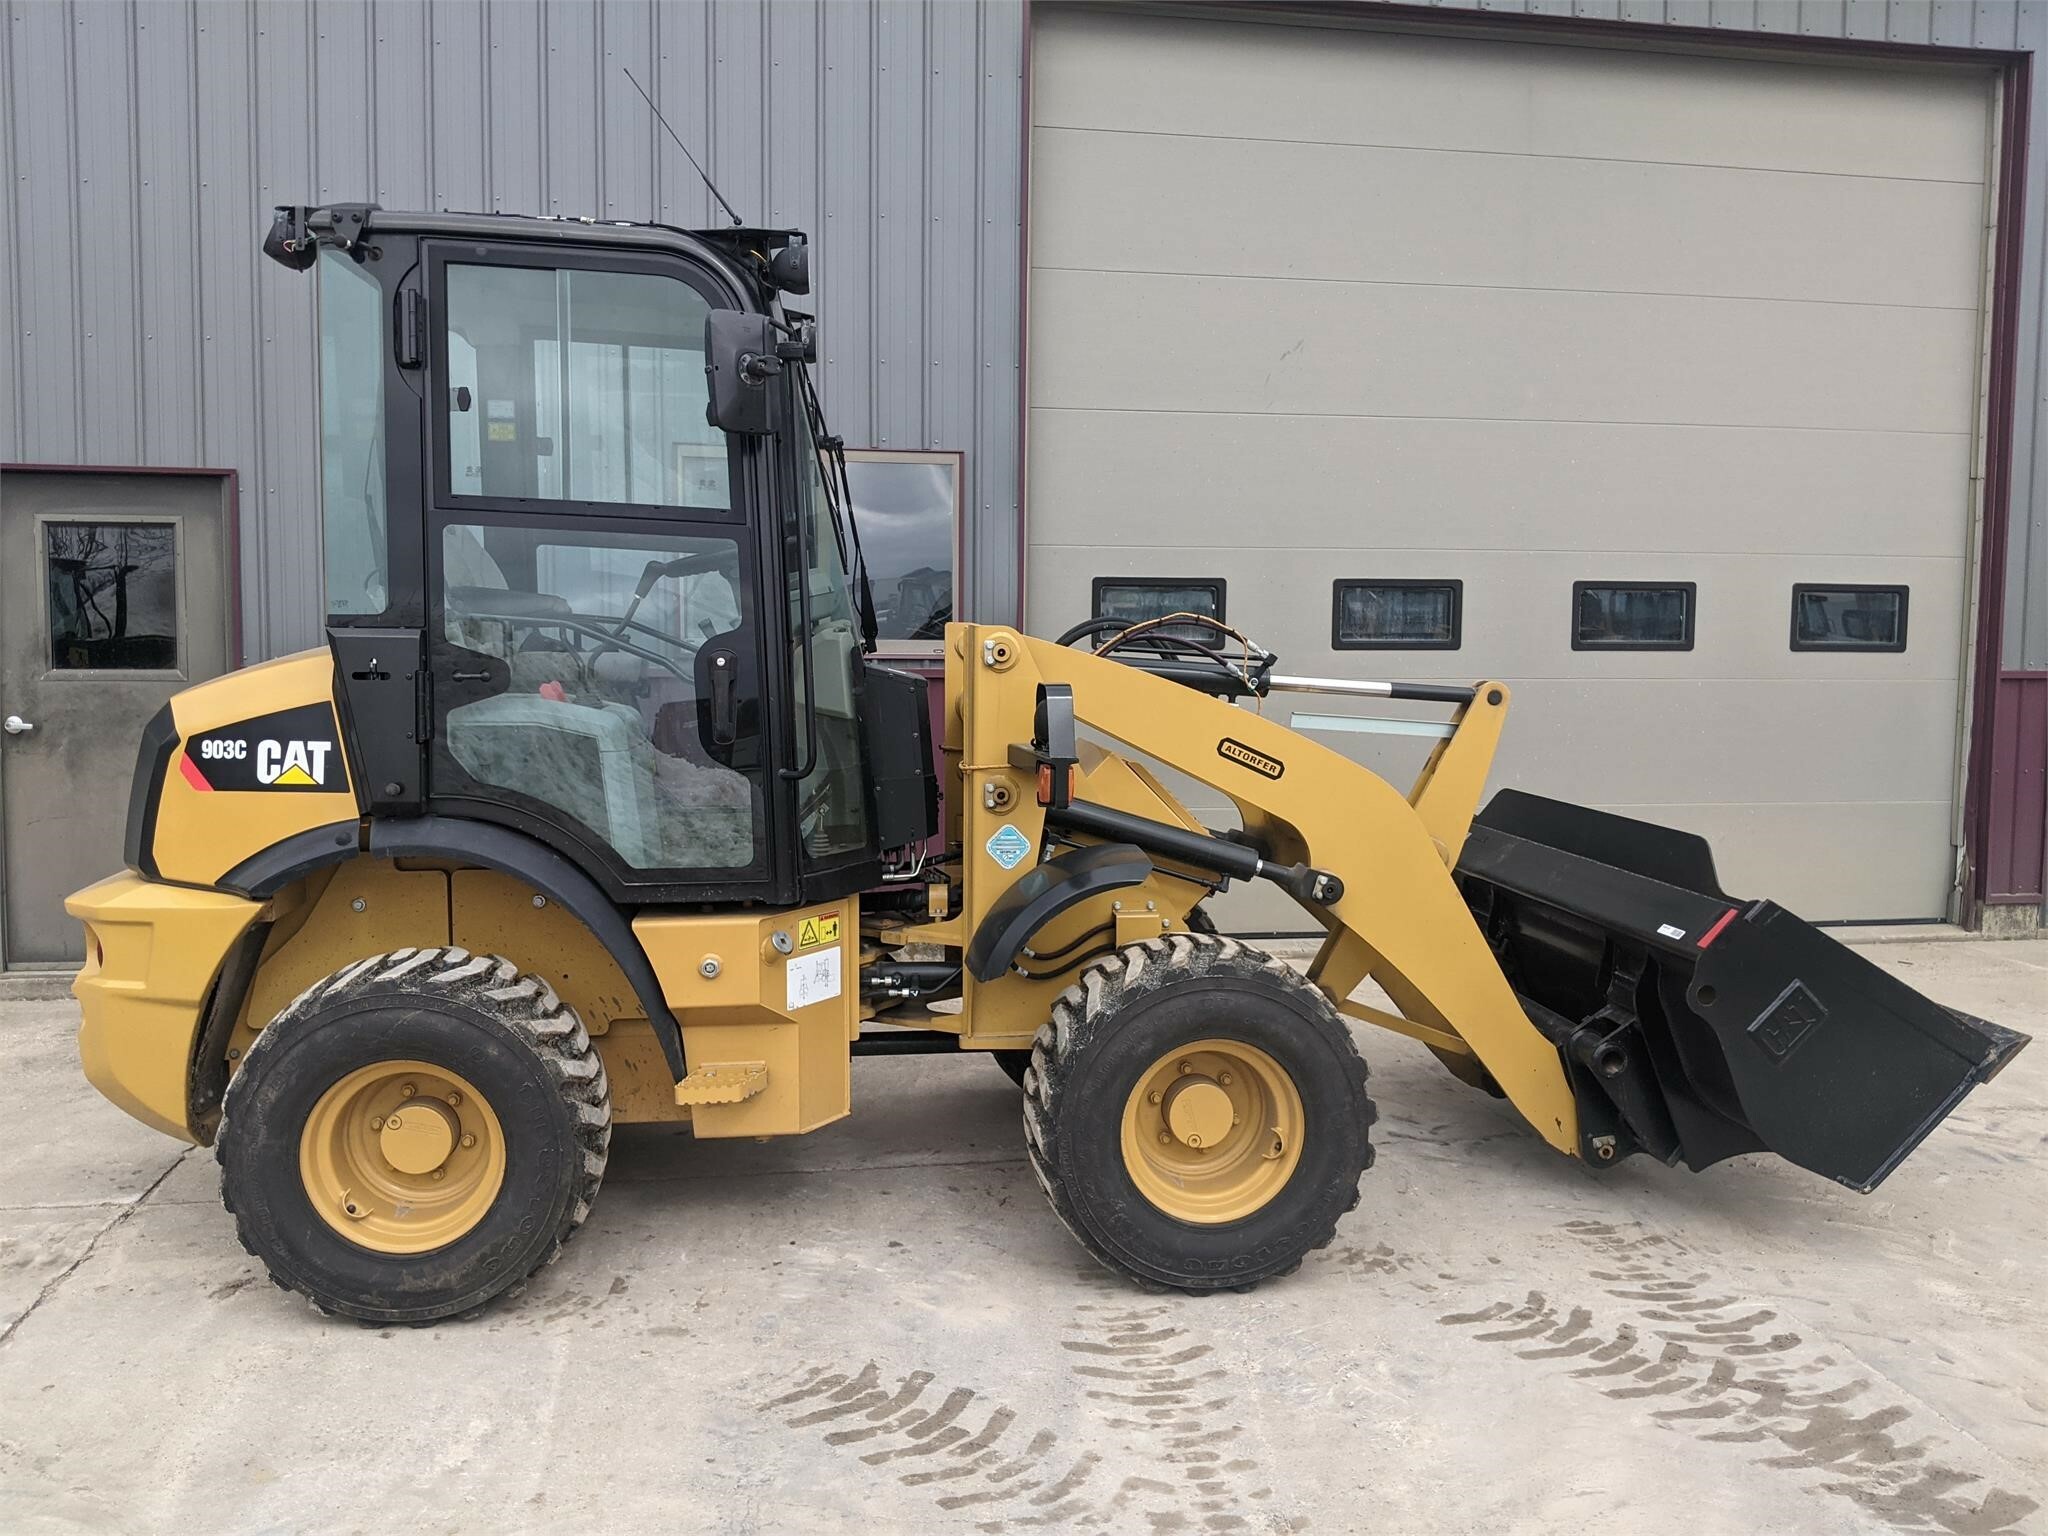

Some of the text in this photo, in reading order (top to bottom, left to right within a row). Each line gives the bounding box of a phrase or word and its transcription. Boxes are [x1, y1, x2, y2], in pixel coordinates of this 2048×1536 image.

[201, 739, 247, 760] 903C
[256, 739, 332, 785] CAT
[1224, 745, 1277, 774] ALTORFER
